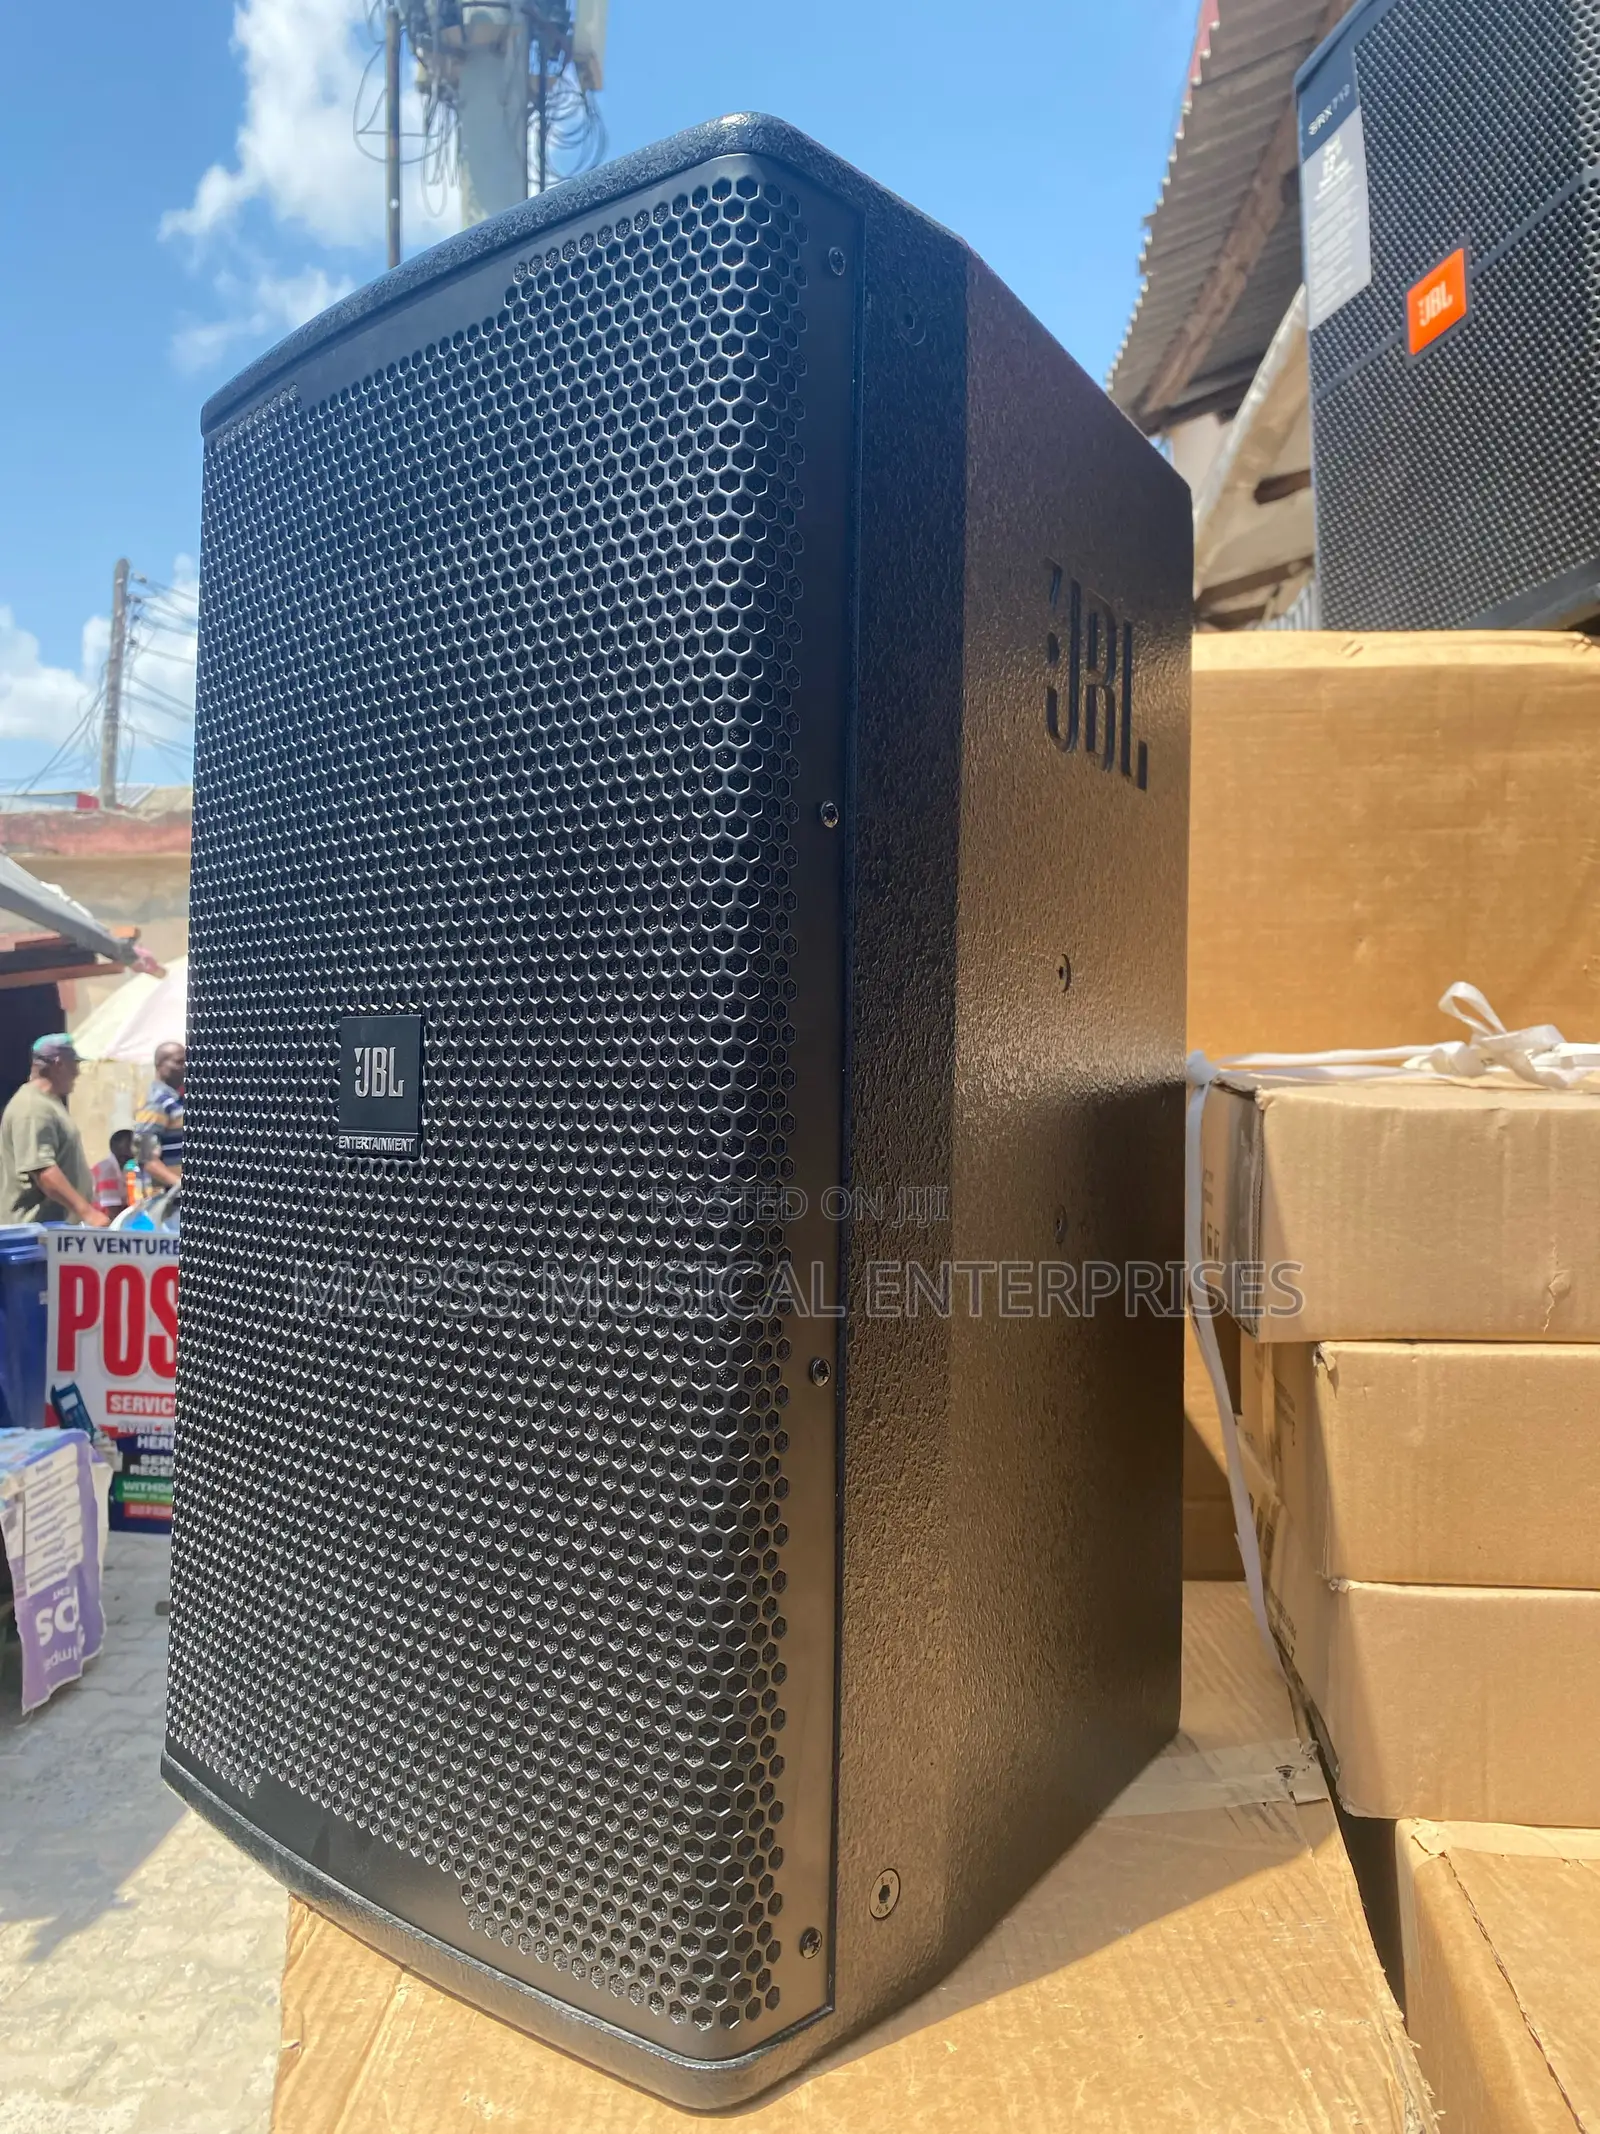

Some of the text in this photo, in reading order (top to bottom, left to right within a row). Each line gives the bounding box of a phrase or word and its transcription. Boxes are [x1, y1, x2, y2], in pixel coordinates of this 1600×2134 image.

[1417, 281, 1453, 327] JBL
[1044, 556, 1148, 791] JBL
[354, 1046, 405, 1098] JBL
[338, 1134, 416, 1153] ENTERTAINMENT
[57, 1236, 86, 1253] IFY
[57, 1264, 178, 1379] POS
